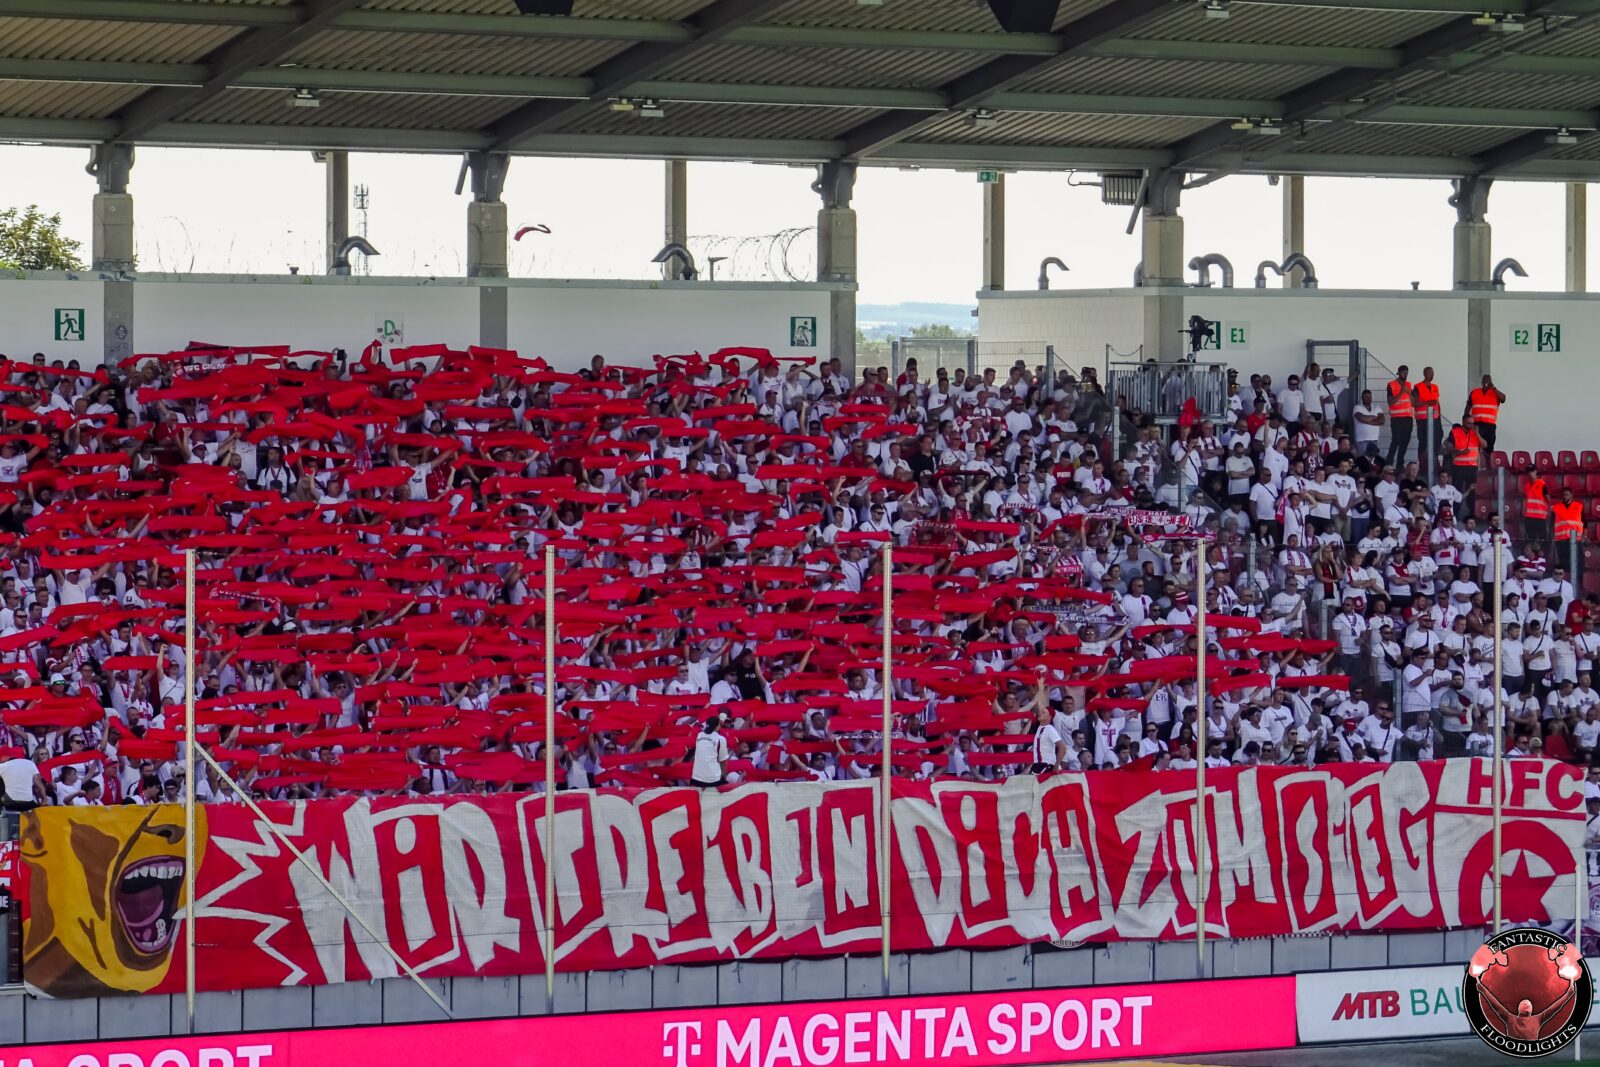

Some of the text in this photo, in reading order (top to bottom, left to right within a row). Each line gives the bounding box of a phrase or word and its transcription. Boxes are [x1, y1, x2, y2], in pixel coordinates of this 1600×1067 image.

[384, 319, 395, 336] D
[1230, 327, 1246, 343] E1
[1514, 330, 1529, 345] E2
[1467, 758, 1585, 811] HFC
[1113, 766, 1278, 938] ZUM
[1331, 990, 1401, 1021] MTB
[716, 1005, 979, 1067] MAGENTA
[987, 995, 1153, 1056] SPORT
